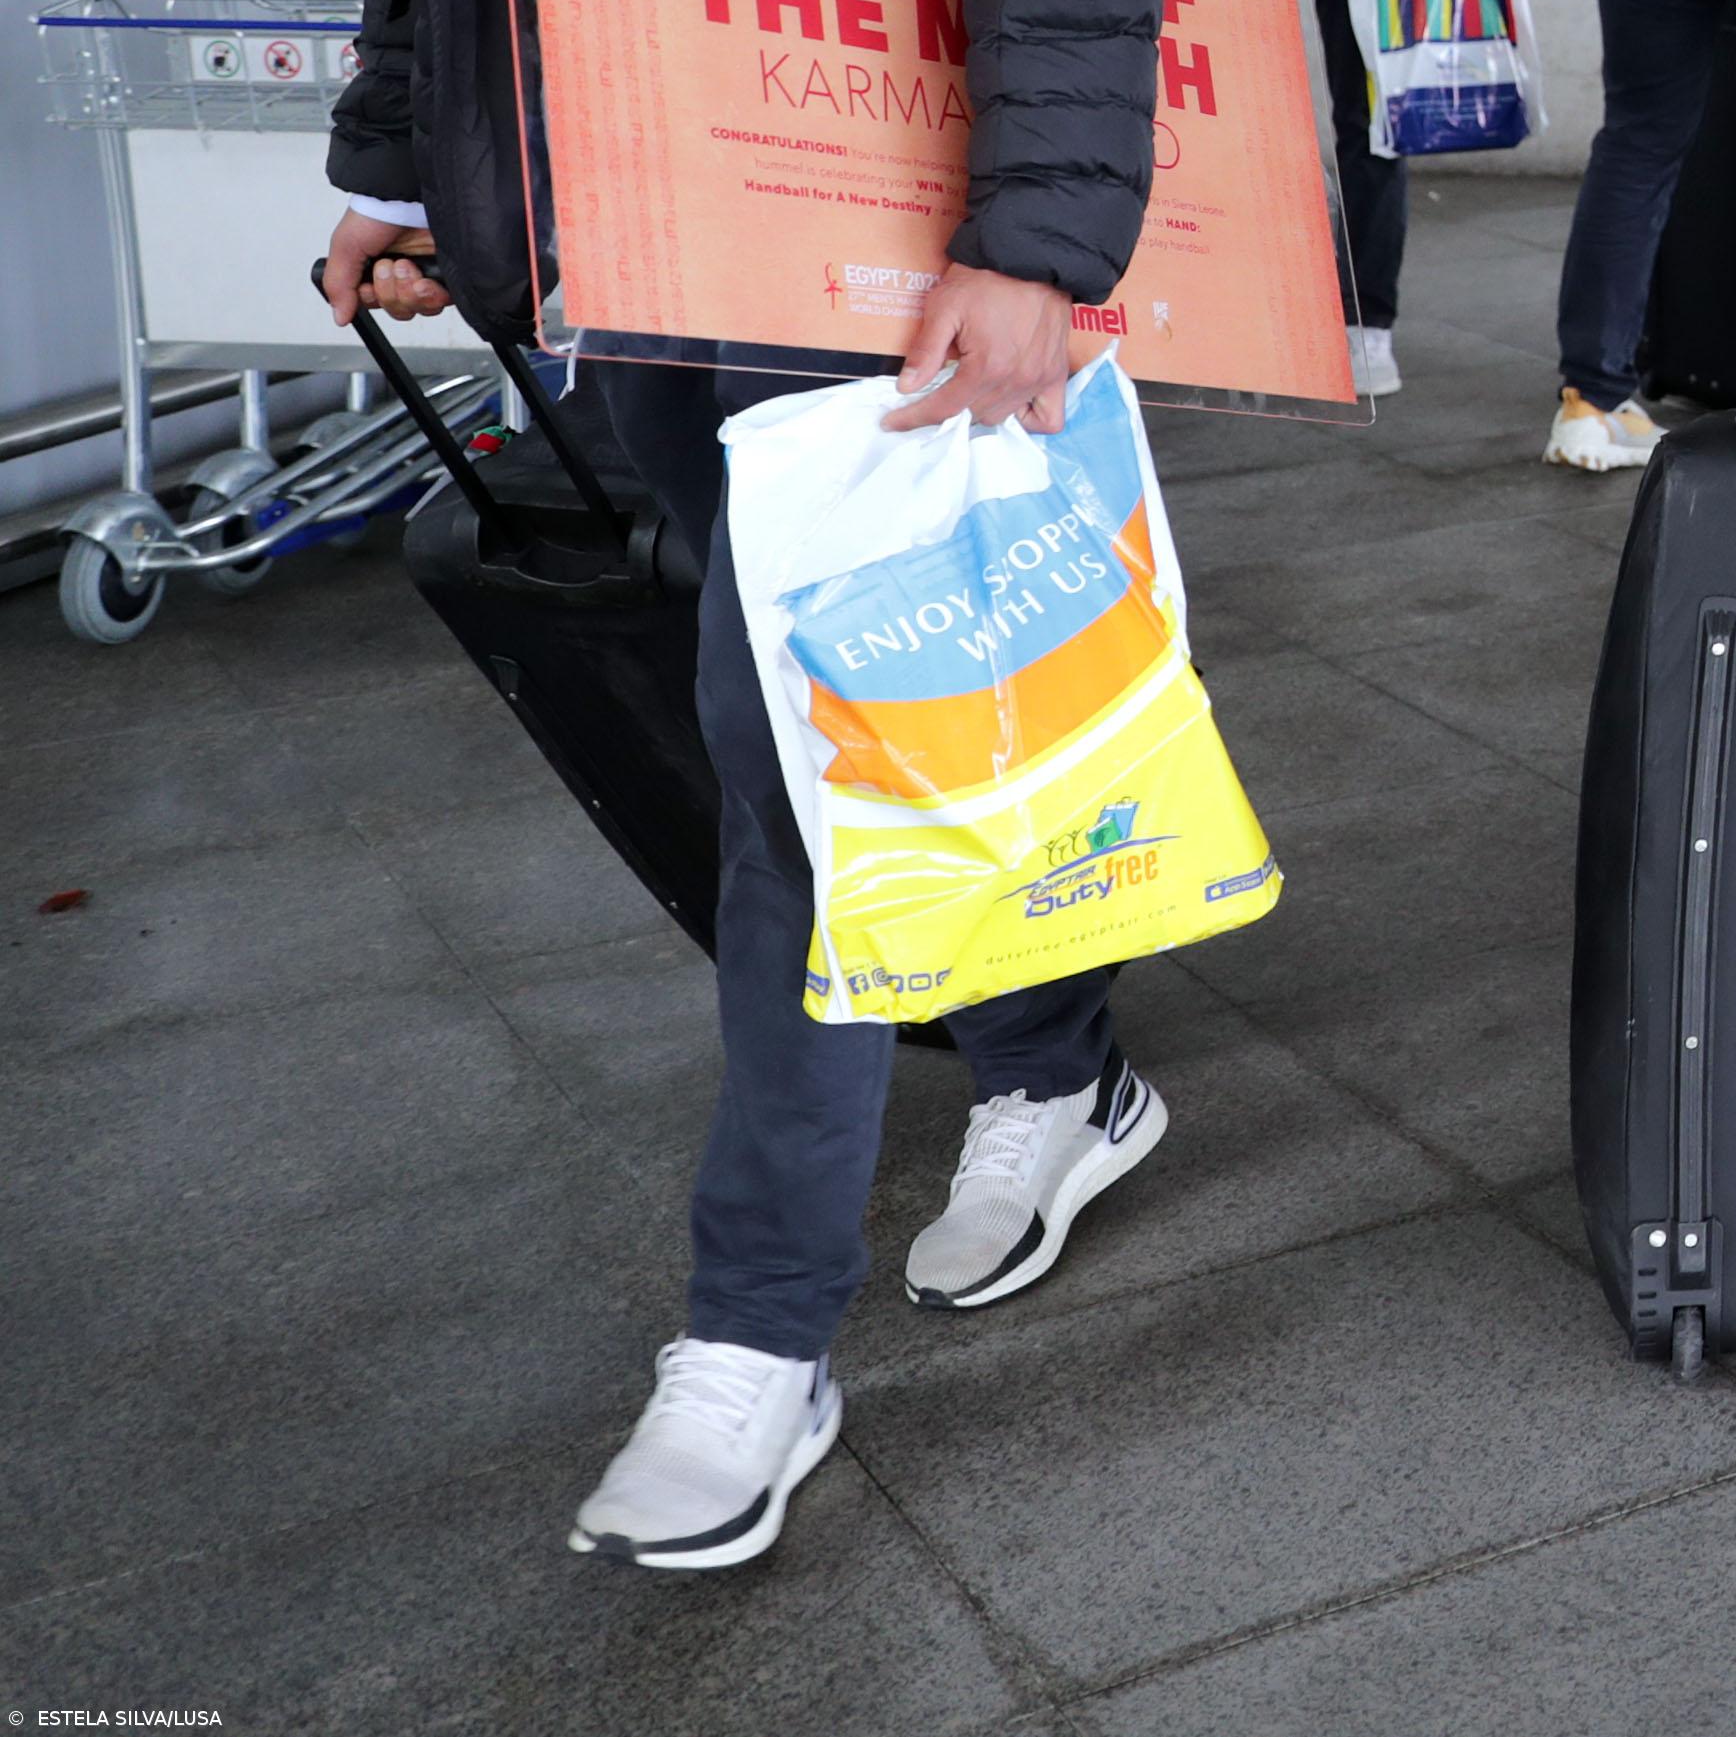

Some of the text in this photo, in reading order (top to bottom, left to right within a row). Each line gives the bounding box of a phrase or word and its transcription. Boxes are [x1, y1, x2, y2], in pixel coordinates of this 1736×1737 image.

[760, 49, 972, 131] KARMA
[710, 126, 848, 157] CONGRATULATIONS!
[851, 149, 886, 163] You're
[755, 158, 803, 174] hummel
[819, 167, 887, 189] celebrating
[888, 177, 914, 190] your
[916, 180, 944, 194] WIN
[744, 179, 810, 199] Handball
[813, 188, 833, 202] for
[836, 192, 847, 203] A
[849, 193, 878, 207] New
[881, 197, 932, 217] Destiny
[1171, 198, 1197, 213] Sierra
[1166, 218, 1201, 233] HAND:
[1148, 237, 1168, 250] play
[1170, 240, 1210, 255] handball
[844, 264, 902, 288] EGYPT
[1072, 302, 1128, 336] mel
[1049, 553, 1107, 594] US
[835, 588, 976, 671] ENJOY
[1024, 850, 1159, 919] Duty free
[1028, 865, 1097, 899] EGYPTAIR
